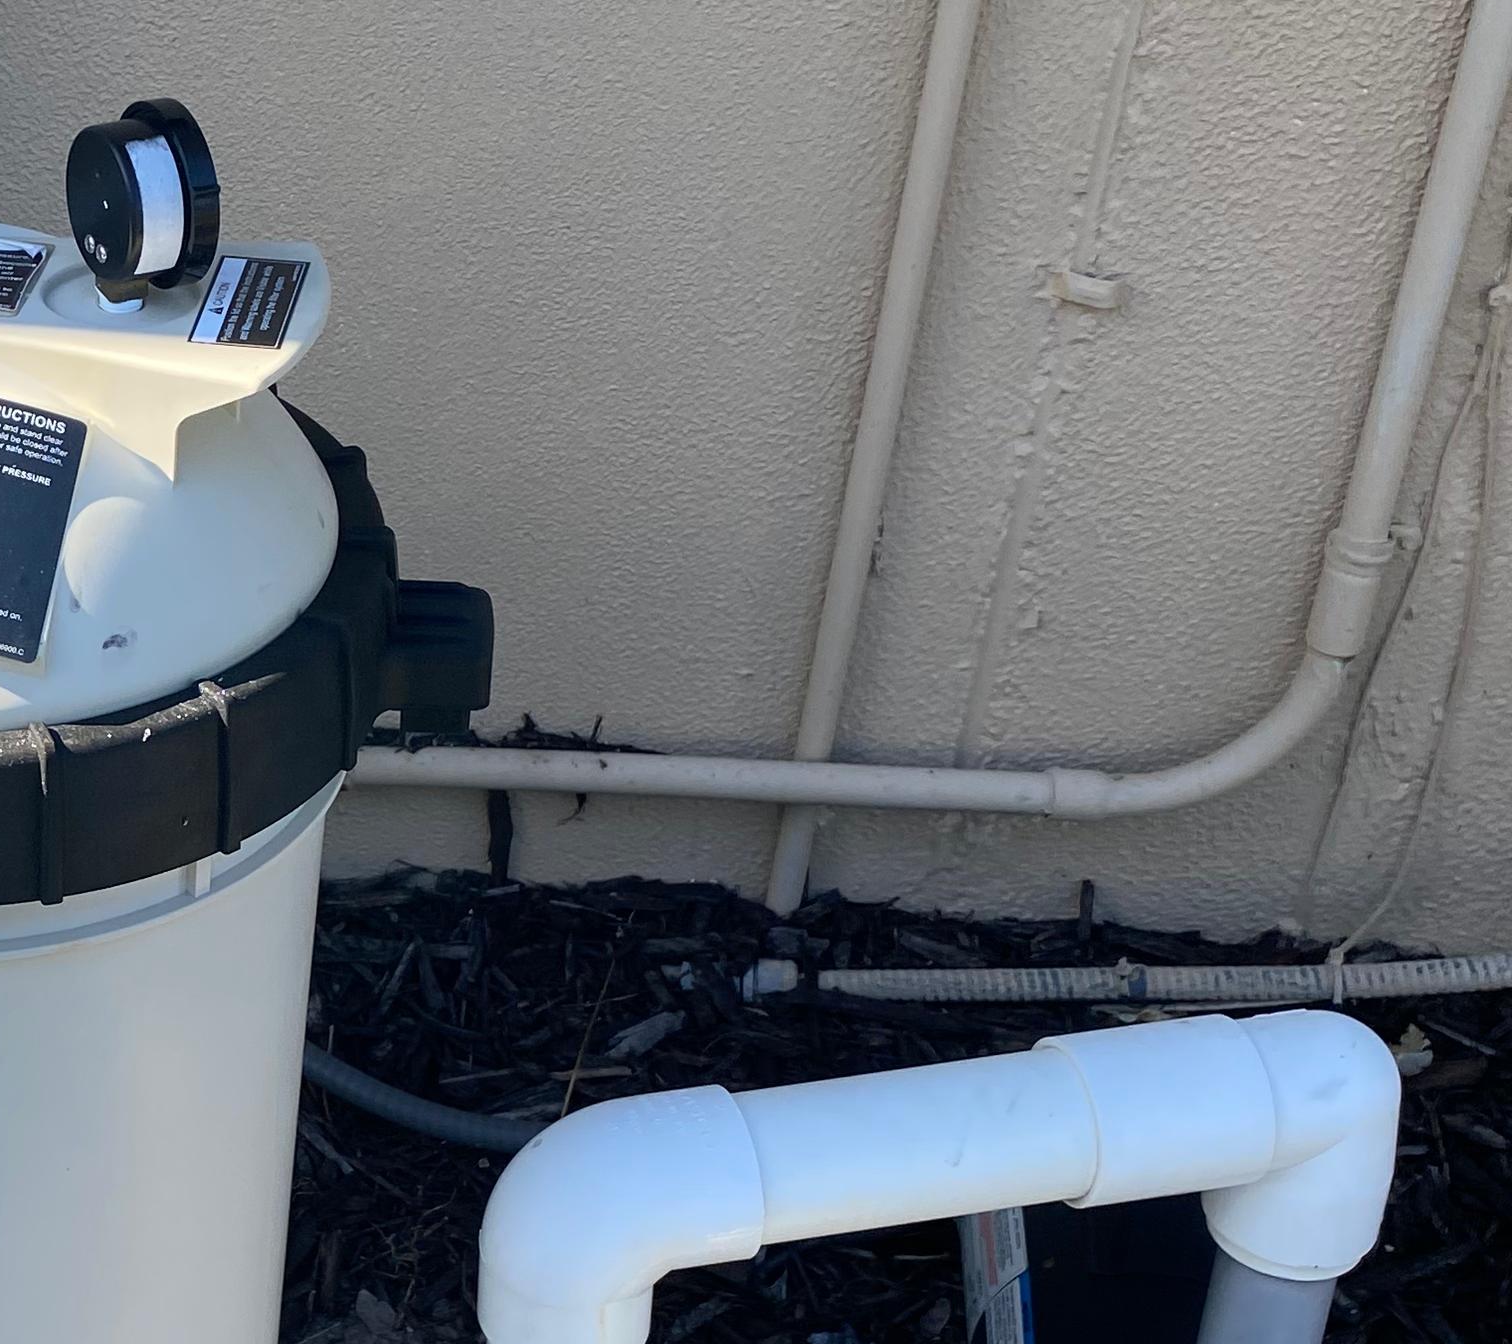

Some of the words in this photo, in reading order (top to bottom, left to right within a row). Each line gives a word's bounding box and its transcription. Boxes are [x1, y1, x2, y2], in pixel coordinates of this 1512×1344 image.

[213, 282, 230, 306] CAUTION
[3, 423, 18, 433] and
[19, 428, 43, 440] stand
[43, 435, 64, 446] clear
[5, 444, 23, 455] safe
[22, 439, 48, 453] closed
[49, 446, 69, 457] after
[1, 465, 51, 487] PRESSURE
[9, 611, 23, 622] on.
